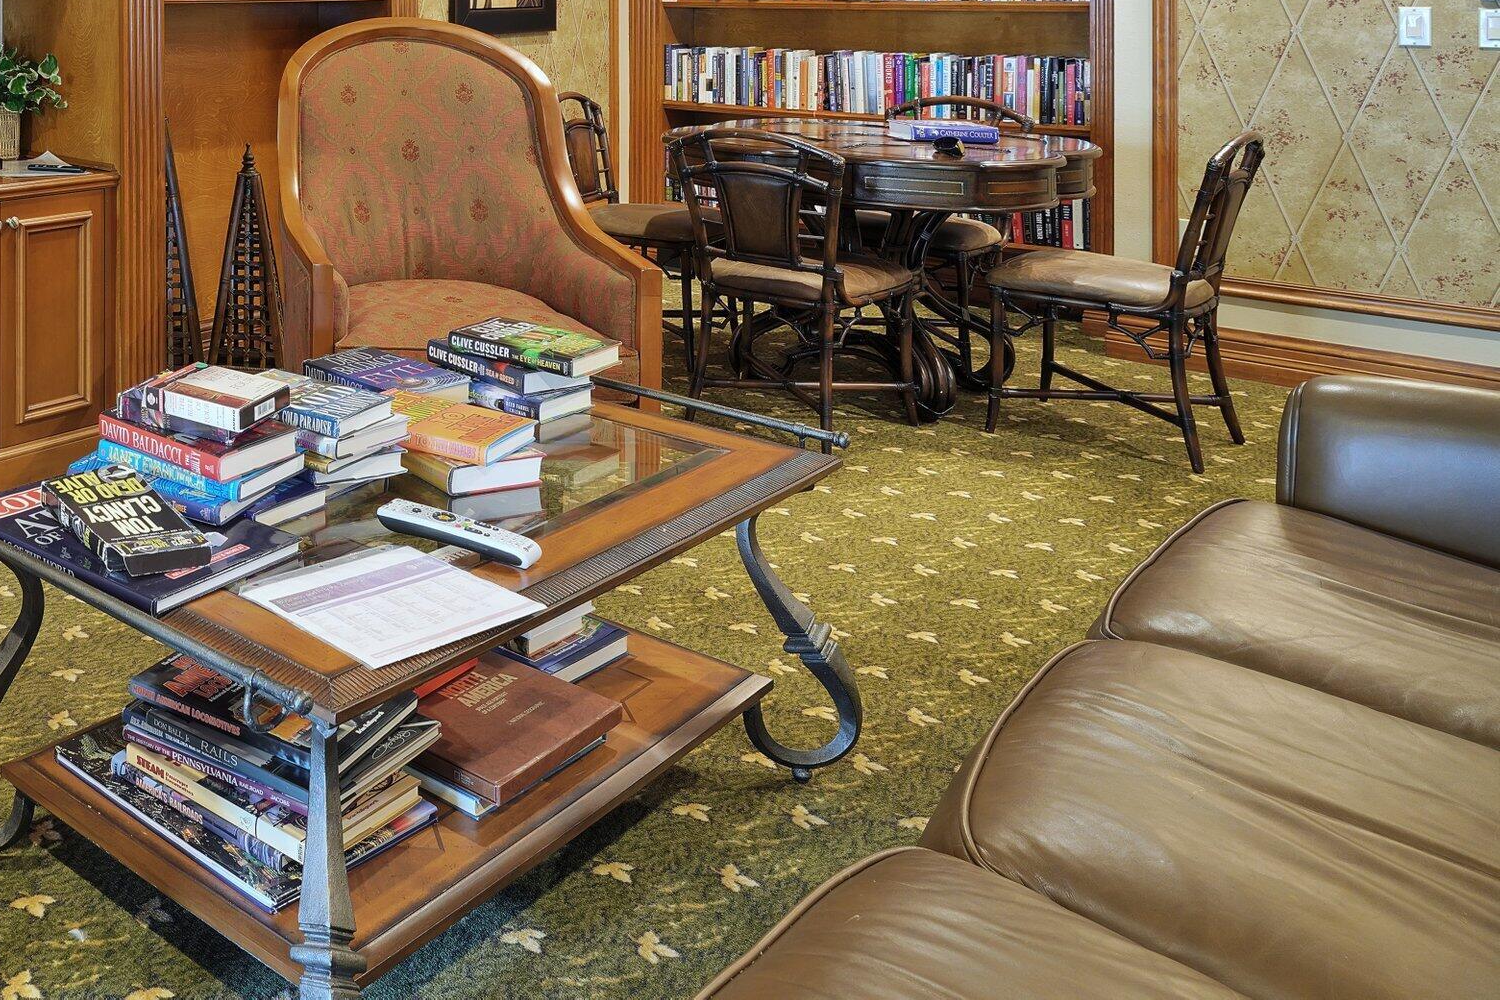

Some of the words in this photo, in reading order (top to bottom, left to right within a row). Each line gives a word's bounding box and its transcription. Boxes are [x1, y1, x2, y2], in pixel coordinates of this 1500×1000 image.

[451, 335, 472, 349] CLIVE
[474, 341, 509, 358] CUSSLER
[429, 346, 447, 363] CLIVE
[448, 352, 478, 374] CUSSLER
[520, 354, 532, 363] EYE
[537, 359, 561, 370] HEAVEN
[305, 365, 325, 382] DAVID
[282, 410, 298, 426] COLD
[300, 412, 332, 436] PARADISE
[101, 419, 129, 444] DAVID
[132, 431, 183, 466] BALDACCI
[108, 446, 141, 471] JANET
[142, 456, 206, 491] EVANOVICH
[50, 472, 101, 494] ALIVE
[68, 488, 98, 504] OR
[96, 477, 146, 496] DEAD
[83, 495, 162, 524] CLANCY
[110, 516, 165, 536] TOM
[457, 673, 519, 707] AMERICA
[192, 706, 241, 736] LOCOMOTIVES
[200, 740, 238, 767] RAILS
[136, 755, 164, 779] STEAM
[172, 750, 238, 787] PENNSYLVANIA
[239, 782, 264, 795] RAILROAD
[270, 794, 291, 807] JACOBS
[169, 794, 203, 824] RAILROADS
